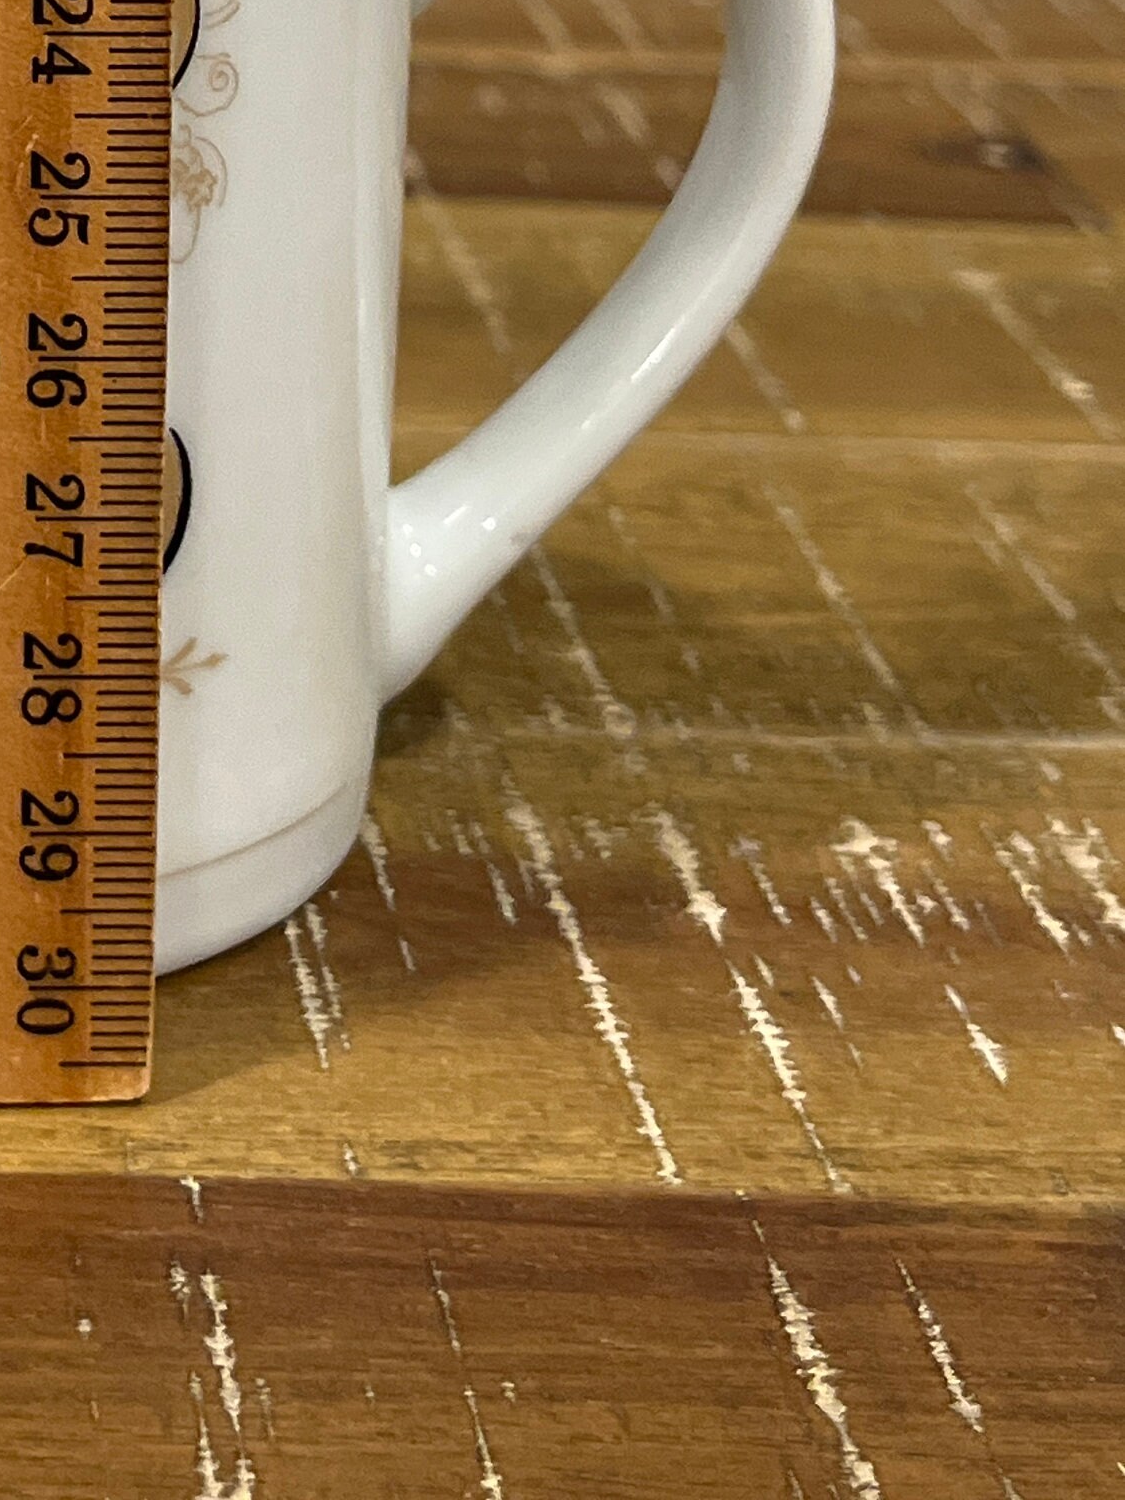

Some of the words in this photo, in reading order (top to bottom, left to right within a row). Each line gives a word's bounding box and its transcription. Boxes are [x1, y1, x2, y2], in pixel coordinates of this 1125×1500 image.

[27, 151, 91, 247] 25
[25, 314, 88, 408] 26
[23, 473, 85, 568] 27
[21, 632, 83, 726] 28
[18, 789, 80, 882] 29
[16, 944, 77, 1035] 30
